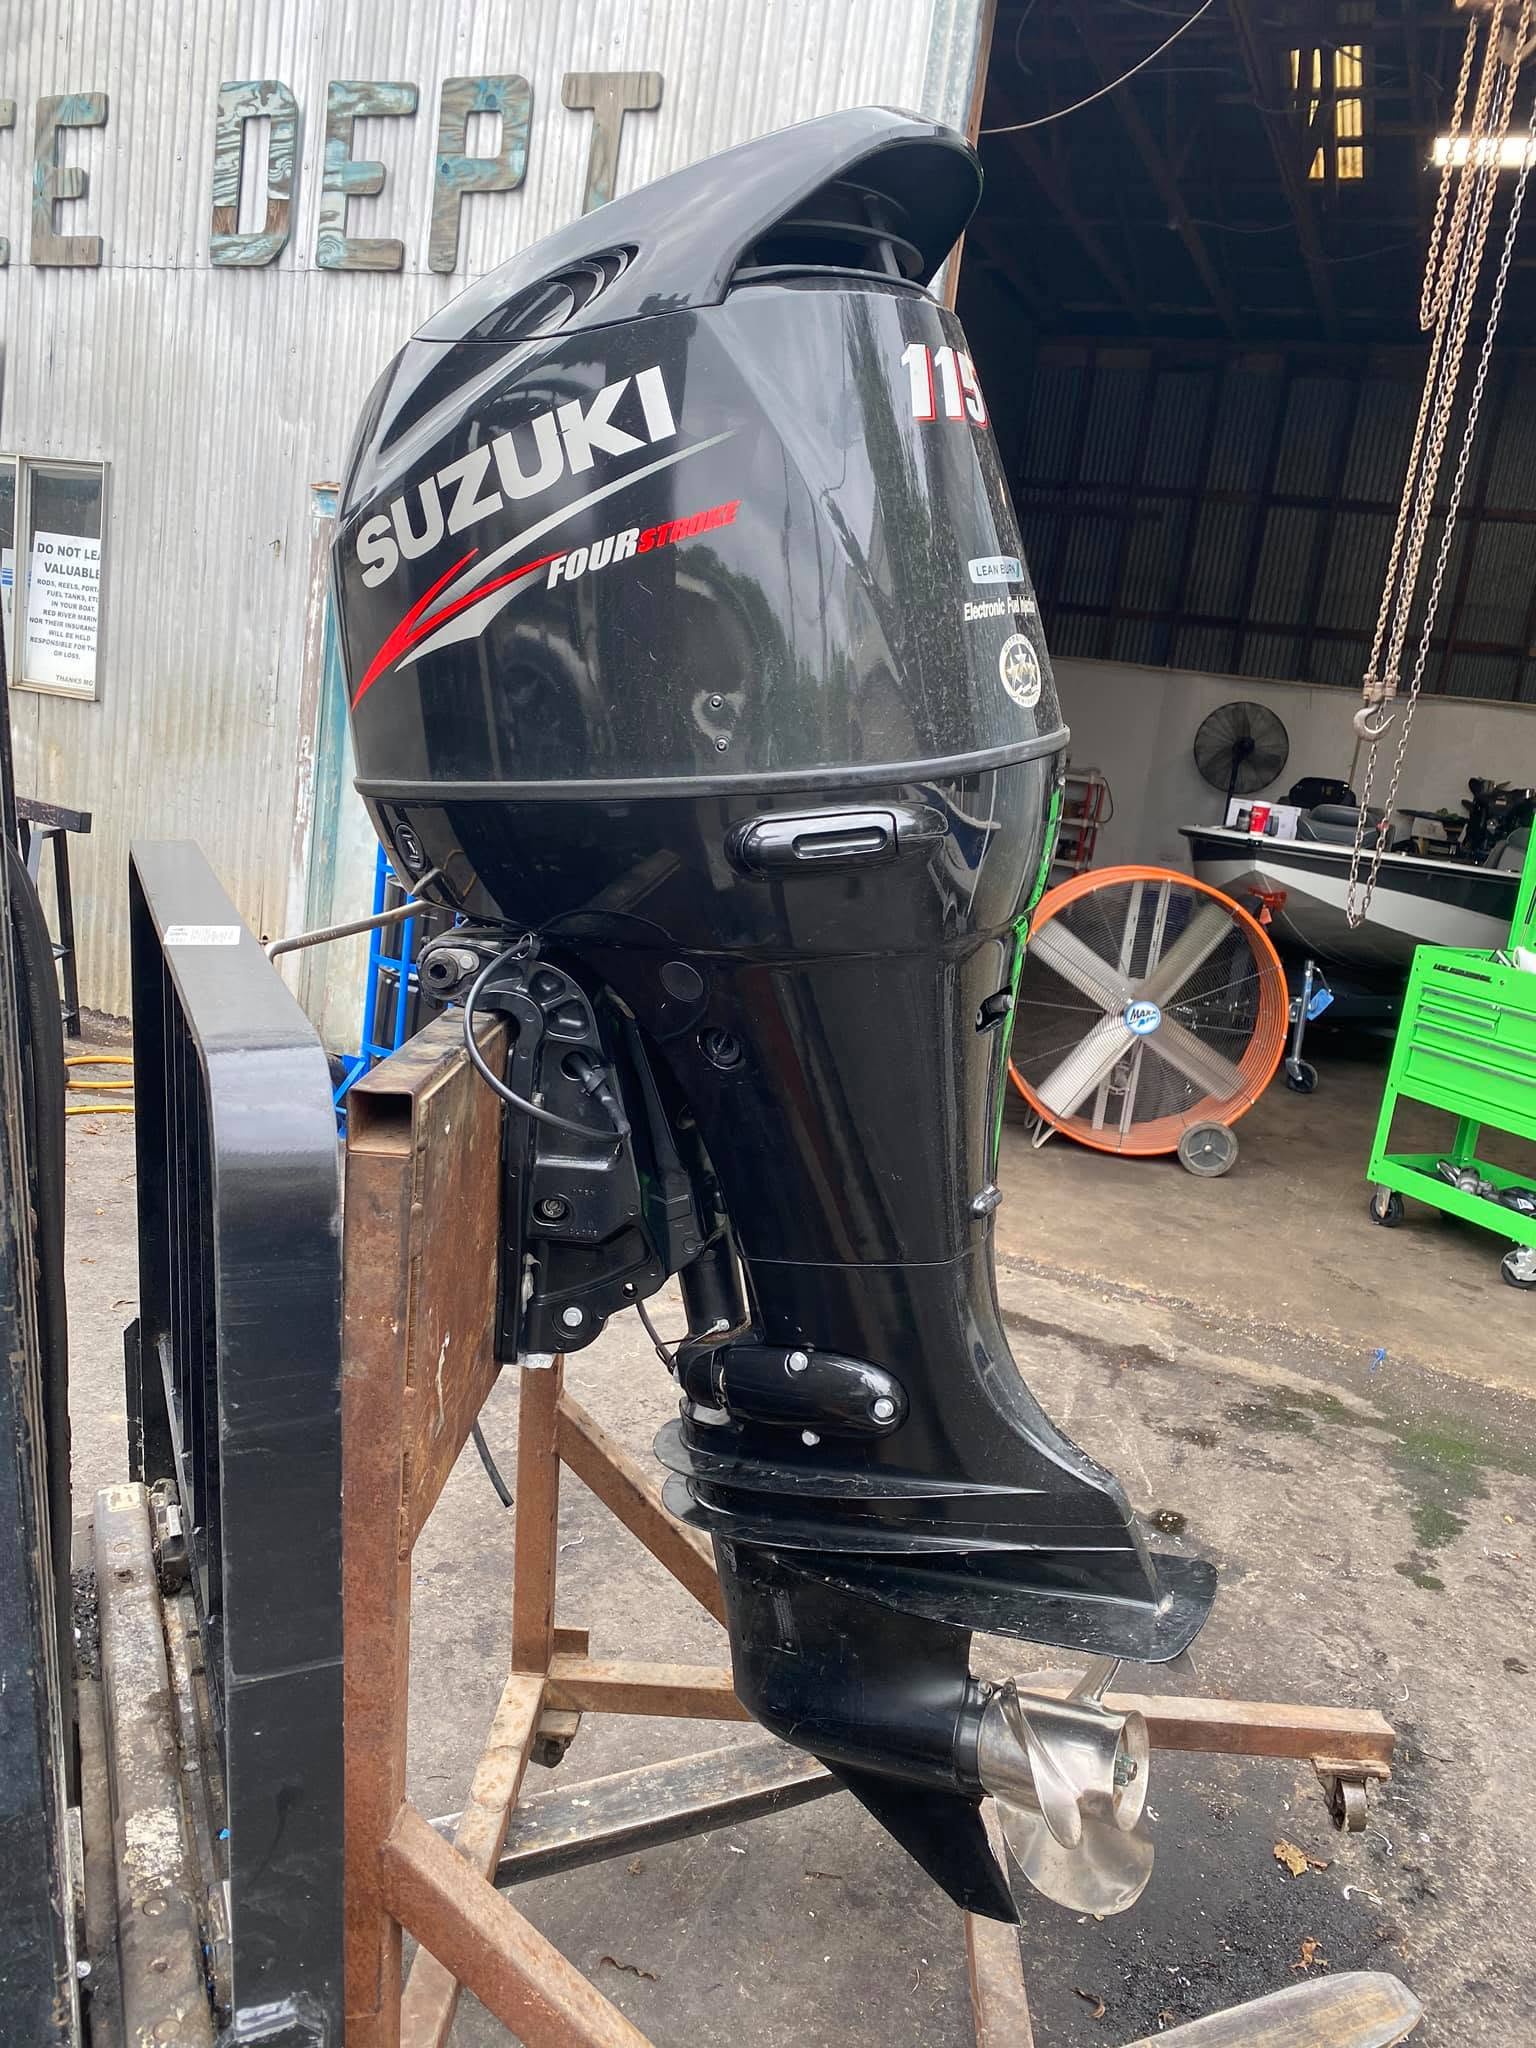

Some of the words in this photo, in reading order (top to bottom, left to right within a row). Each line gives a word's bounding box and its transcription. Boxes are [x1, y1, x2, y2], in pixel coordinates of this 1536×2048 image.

[0, 92, 109, 267] E
[209, 72, 664, 274] DEPT
[900, 342, 988, 429] 115
[356, 365, 677, 589] SUZUKI
[37, 542, 54, 554] DO
[57, 545, 81, 558] NOT
[976, 564, 999, 577] LEAN
[47, 590, 63, 598] FUEL
[51, 599, 58, 607] IN
[60, 601, 78, 610] YOUR
[964, 597, 1006, 621] Electronic
[43, 609, 56, 617] RED
[57, 610, 77, 619] RIVER
[29, 616, 43, 625] NOR
[45, 618, 64, 627] THEIR
[48, 629, 64, 638] WILL
[75, 634, 91, 642] HELD
[29, 636, 73, 649] RESPONSIBLE
[73, 643, 86, 651] FOR
[56, 674, 82, 684] THANKS
